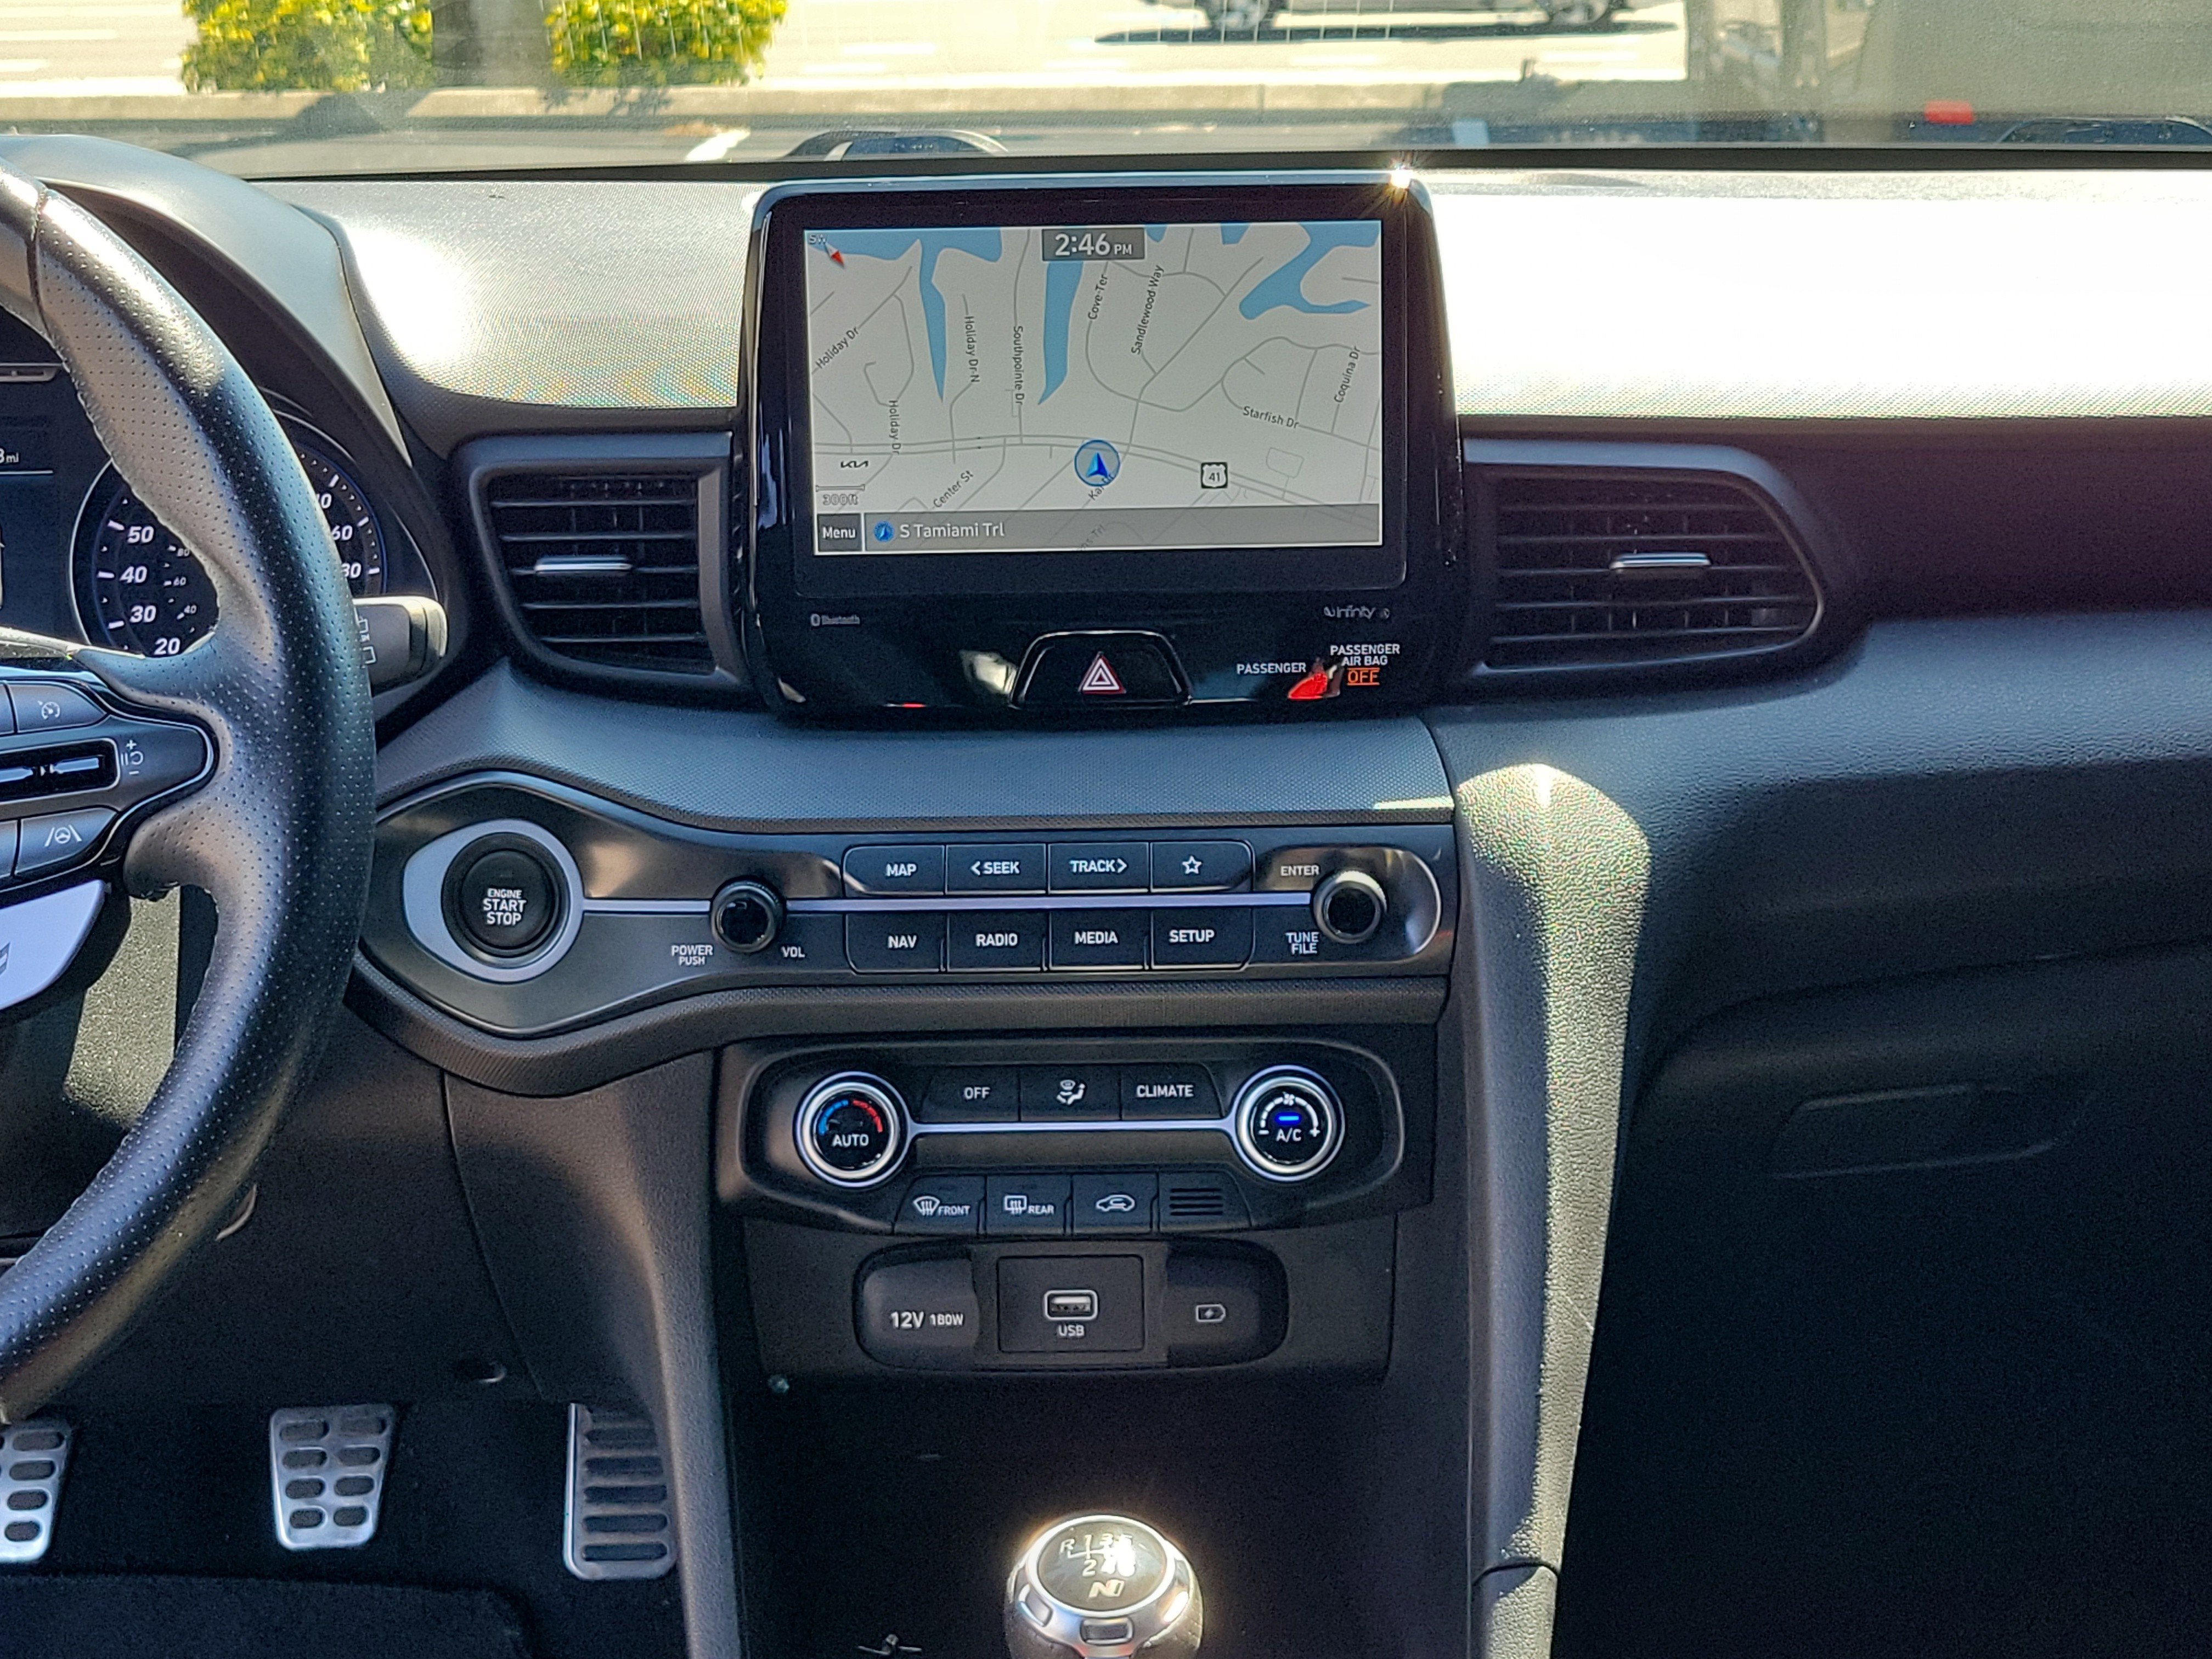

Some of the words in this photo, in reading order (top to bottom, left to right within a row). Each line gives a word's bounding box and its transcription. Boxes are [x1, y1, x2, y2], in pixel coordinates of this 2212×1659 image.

[1055, 233, 1111, 256] 2:46
[1114, 244, 1132, 255] PM
[1095, 274, 1108, 291] Ter
[1088, 295, 1103, 319] Cove
[1131, 290, 1156, 355] Sandlewood
[1148, 265, 1164, 287] Way
[964, 316, 977, 356] Holiday
[815, 337, 849, 369] Holiday
[846, 327, 860, 340] Dr
[968, 359, 979, 371] Dr
[1012, 326, 1024, 390] Southpointe
[1334, 362, 1356, 403] Coquina
[1348, 346, 1361, 360] Dr
[1015, 393, 1025, 405] Dr
[889, 400, 900, 440] Holiday
[1243, 405, 1283, 425] Starfish
[1286, 418, 1299, 428] Dr
[892, 443, 901, 455] Dr
[1209, 472, 1221, 482] 41
[933, 479, 962, 509] Center
[961, 470, 974, 482] St
[823, 494, 858, 505] 300ft
[127, 526, 154, 544] 50
[822, 526, 856, 539] Menu
[900, 524, 910, 538] S
[913, 523, 979, 538] Tamiami
[983, 523, 1005, 537] Trl
[120, 566, 148, 583] 40
[173, 577, 187, 586] 60
[129, 605, 156, 623] 30
[184, 605, 197, 614] 40
[154, 637, 180, 655] 20
[1330, 643, 1400, 656] PASSENGER
[1342, 656, 1362, 667] AIR
[1364, 655, 1388, 666] BAG
[1236, 662, 1306, 675] PASSENGER
[1347, 670, 1378, 684] OFF
[885, 864, 917, 877] MAP
[1280, 865, 1319, 876] ENTER
[487, 888, 522, 899] ENGINE
[482, 898, 527, 913] START
[486, 911, 522, 926] STOP
[888, 935, 917, 949] NAV
[975, 933, 1018, 947] RADIO
[1074, 932, 1119, 945] MEDIA
[1169, 930, 1215, 943] SETUP
[1285, 932, 1319, 944] TUNE
[671, 944, 713, 957] POWER
[781, 946, 805, 958] VOL
[1291, 943, 1318, 955] FILE
[679, 956, 706, 966] PUSH
[963, 1087, 990, 1099] OFF
[1136, 1084, 1194, 1098] CLIMATE
[832, 1133, 869, 1147] AUTO
[1276, 1128, 1302, 1142] A/C
[938, 1205, 970, 1216] FRONT
[1028, 1204, 1054, 1215] REAR
[890, 1311, 924, 1329] 12V
[929, 1313, 964, 1327] 180W
[1057, 1324, 1086, 1337] USB
[1060, 1538, 1075, 1553] R
[1082, 1559, 1097, 1577] 2
